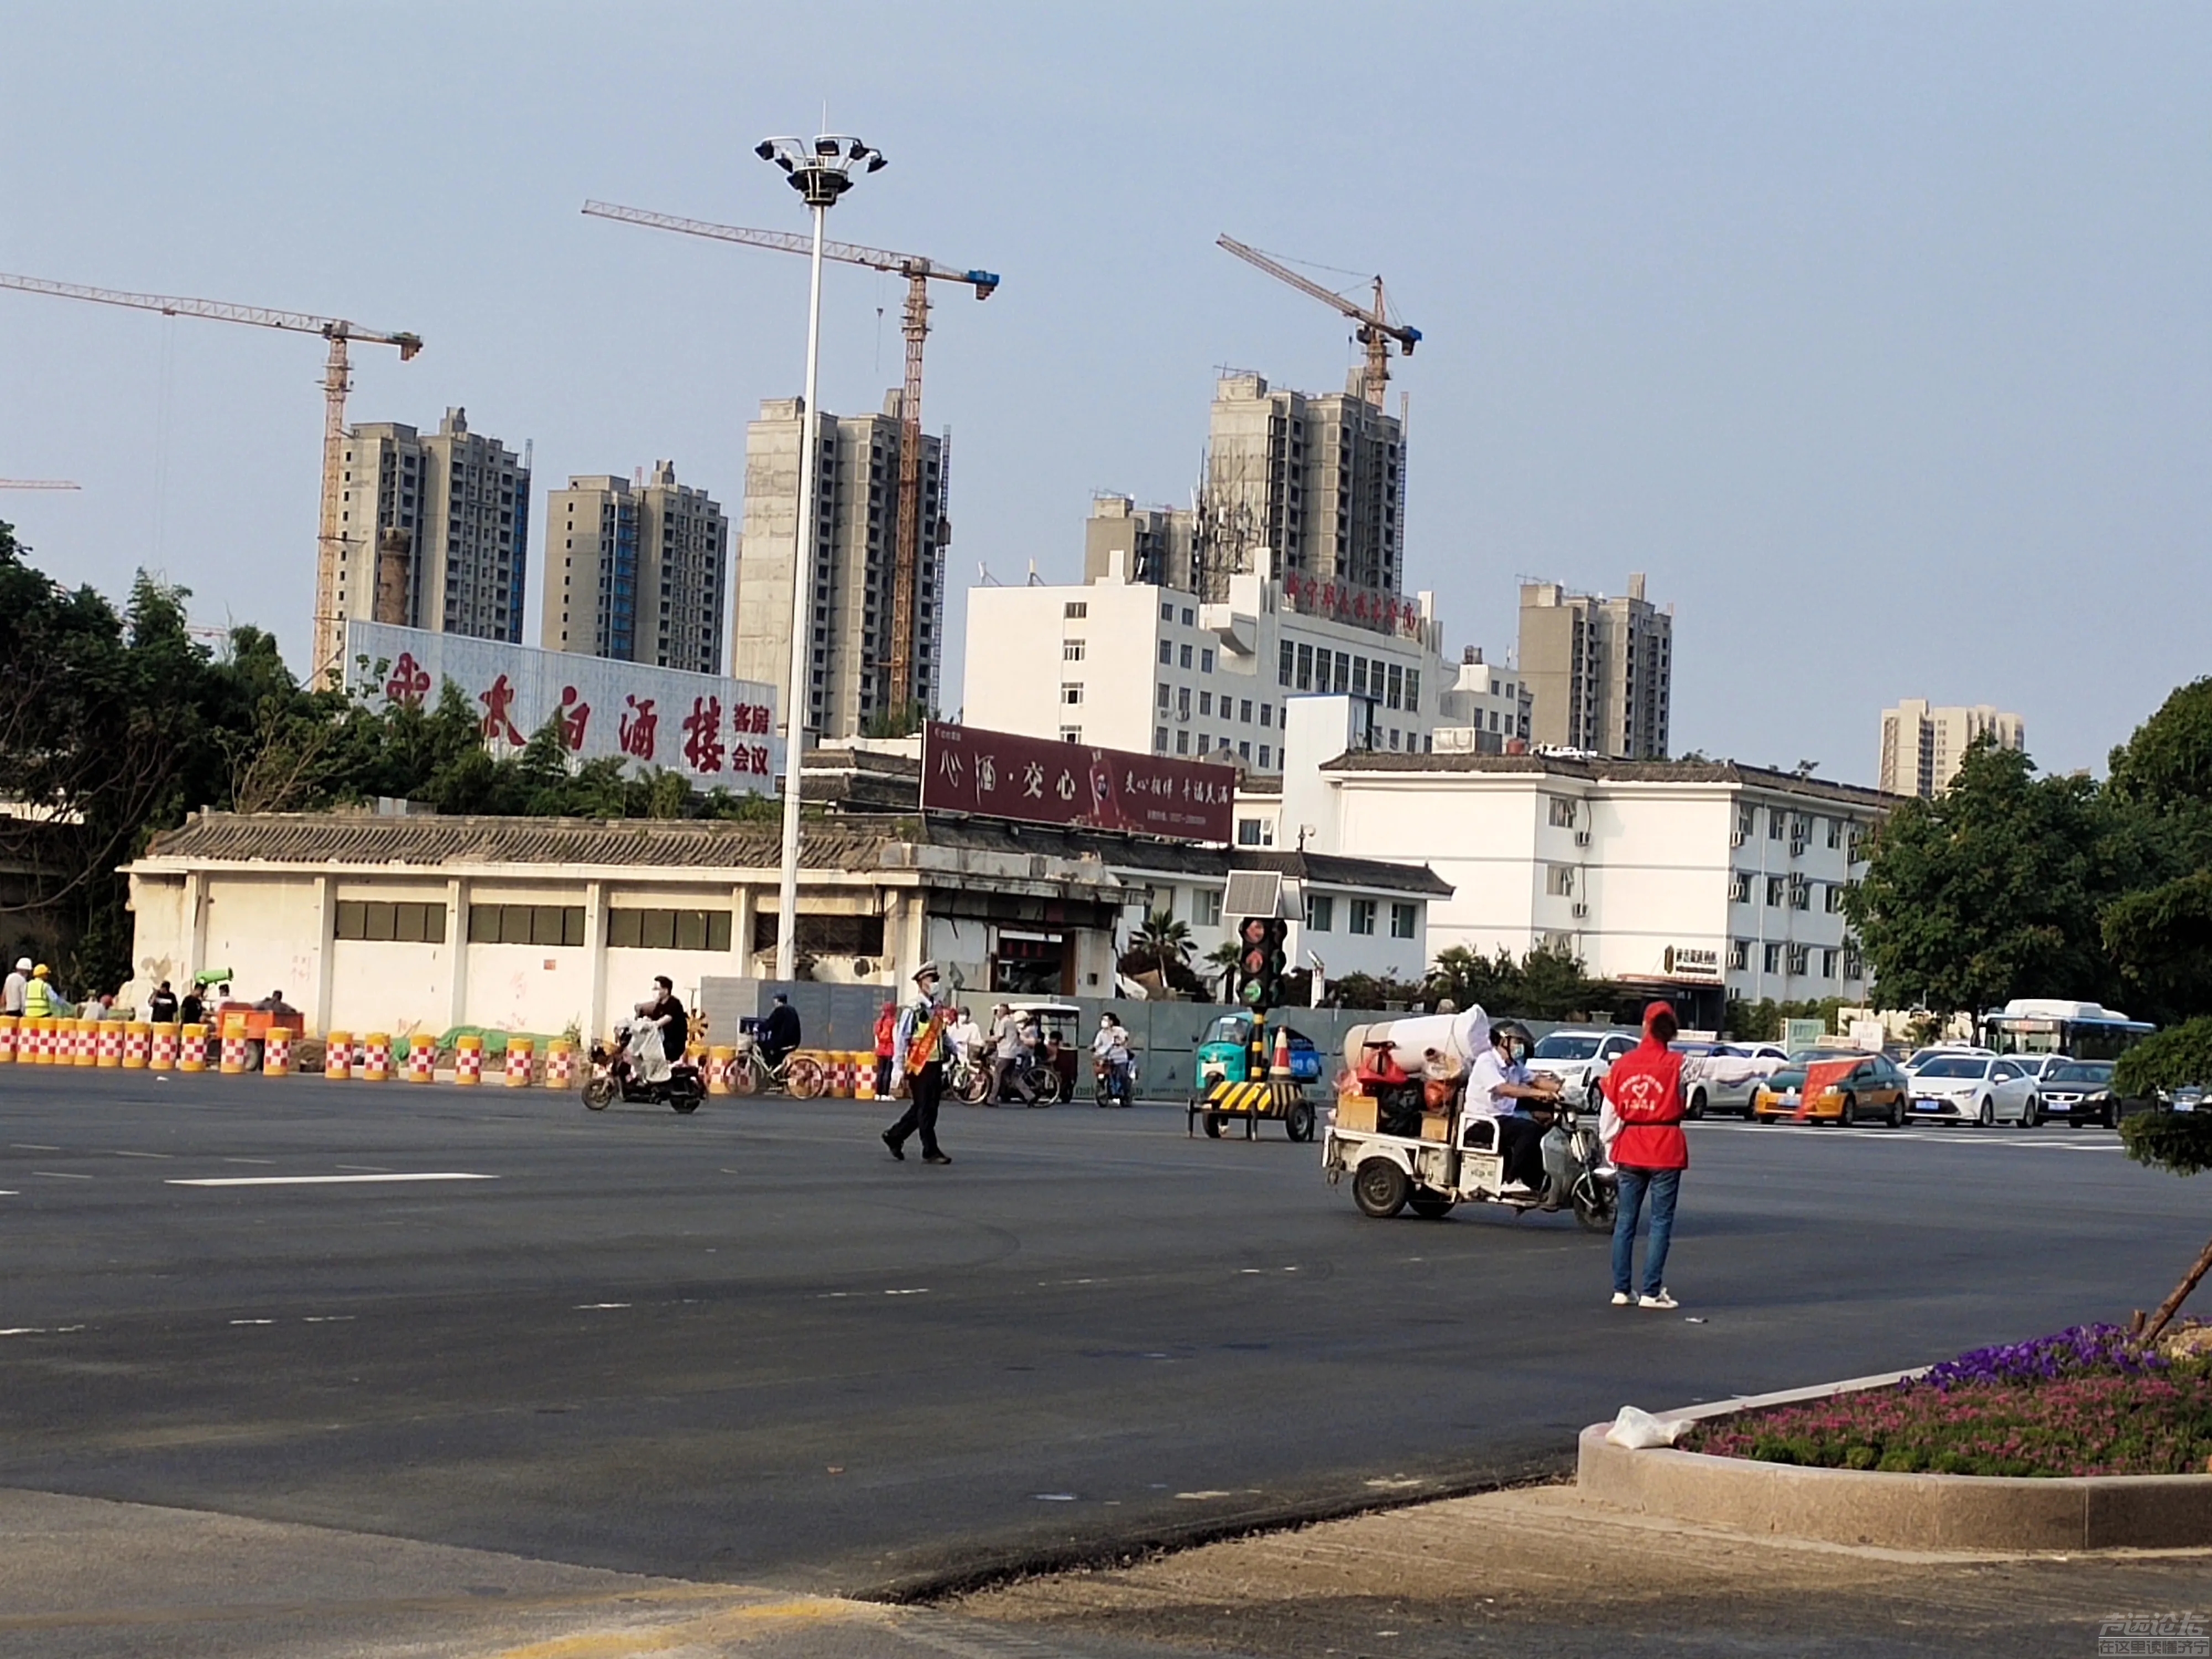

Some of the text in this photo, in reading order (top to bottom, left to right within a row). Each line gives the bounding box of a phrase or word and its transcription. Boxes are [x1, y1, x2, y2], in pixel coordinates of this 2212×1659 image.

[478, 674, 726, 773] 太白酒楼
[733, 702, 769, 735] 客房
[731, 742, 769, 775] 会议
